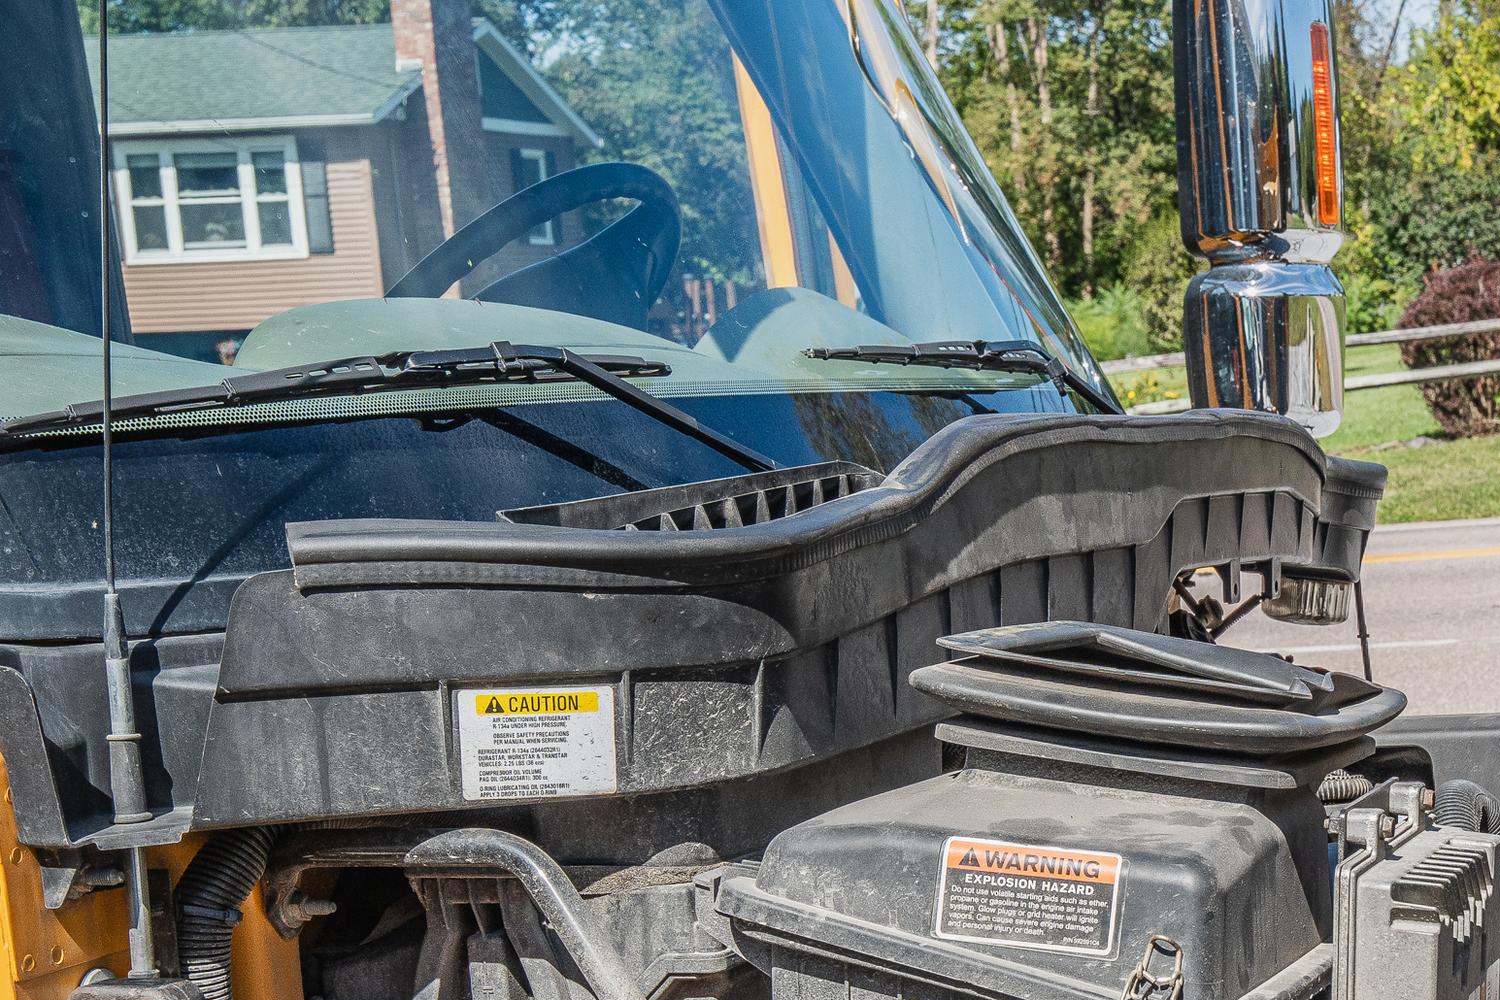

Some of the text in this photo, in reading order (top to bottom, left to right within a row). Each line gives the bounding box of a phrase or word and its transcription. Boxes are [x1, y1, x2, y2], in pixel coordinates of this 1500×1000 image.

[509, 695, 579, 712] CAUTION
[985, 850, 1100, 878] WARNING
[965, 874, 1094, 895] EXPLOSION HAZARD
[950, 895, 979, 903] propane
[990, 899, 1018, 907] gasoline
[1077, 907, 1098, 915] intake
[1016, 892, 1042, 902] starting
[1089, 900, 1108, 908] ether,
[949, 912, 974, 920] vapors.
[992, 916, 1013, 924] cause
[1040, 921, 1064, 929] engine
[1065, 923, 1094, 933] damage
[978, 905, 996, 913] Glow
[998, 907, 1016, 917] plugs
[1079, 916, 1098, 924] ignite
[962, 922, 993, 930] personal
[994, 925, 1013, 934] injury
[1024, 927, 1045, 936] death.
